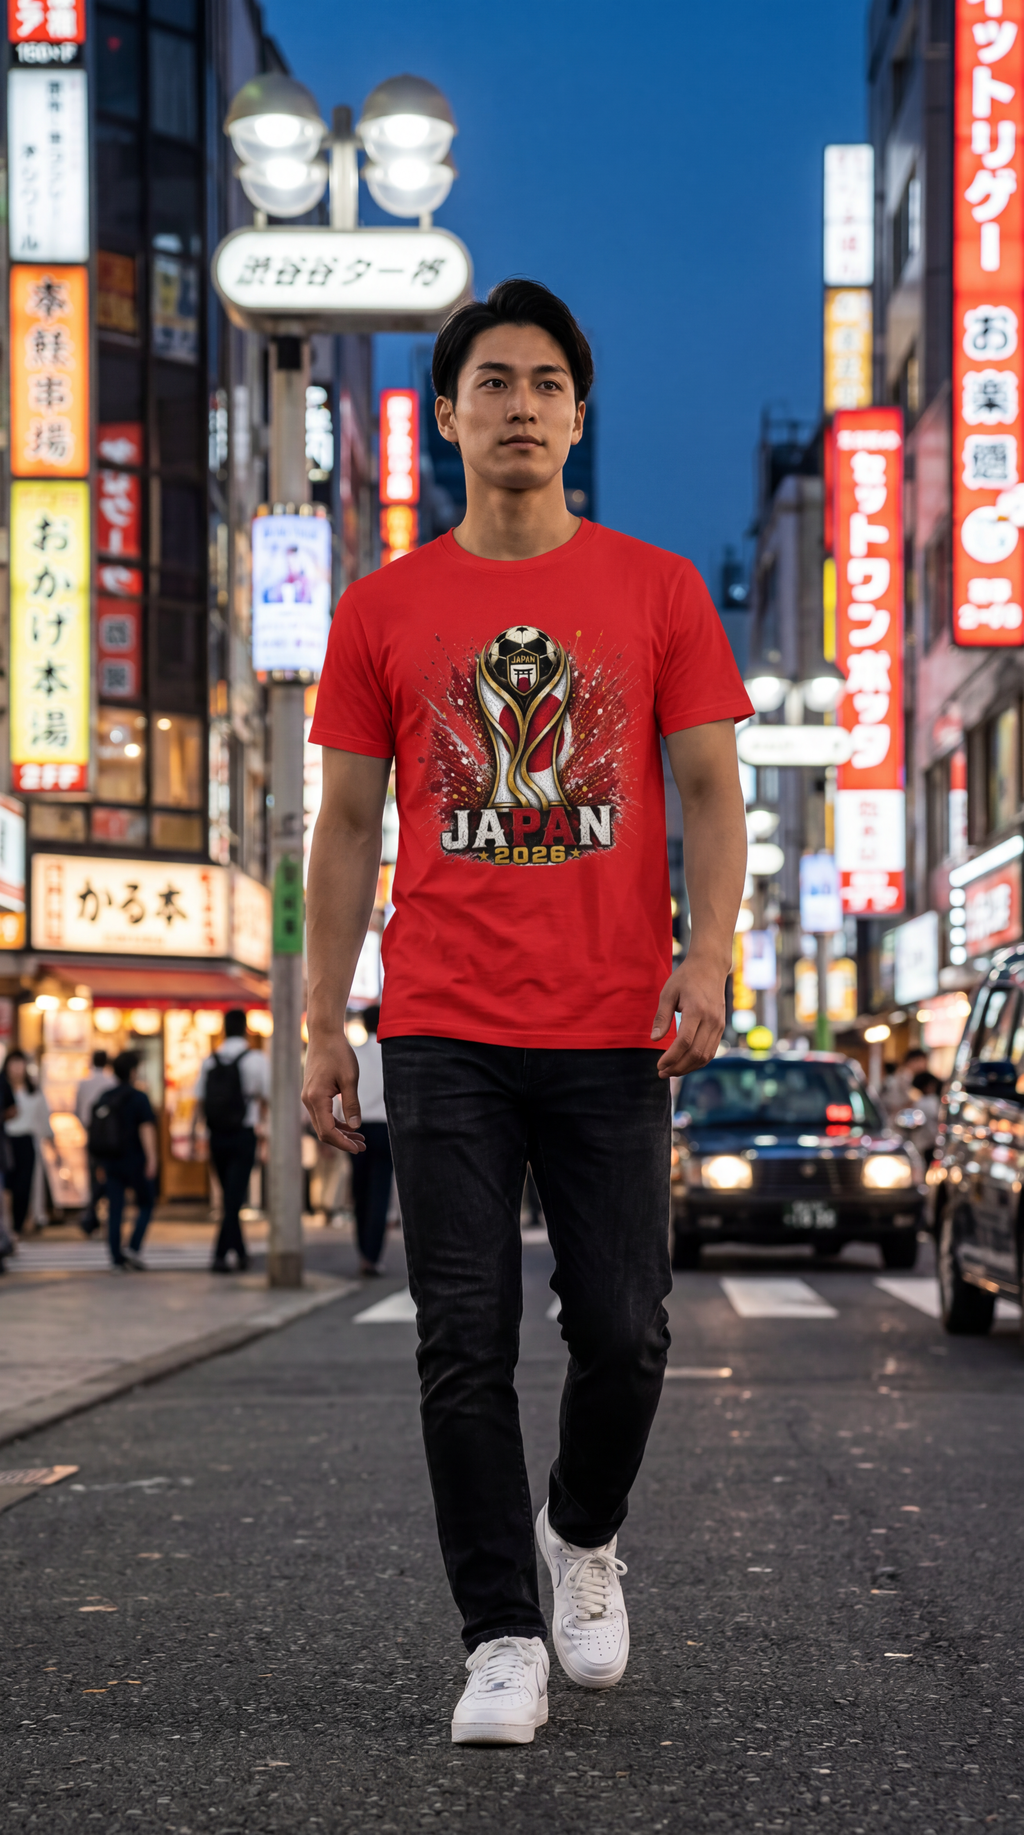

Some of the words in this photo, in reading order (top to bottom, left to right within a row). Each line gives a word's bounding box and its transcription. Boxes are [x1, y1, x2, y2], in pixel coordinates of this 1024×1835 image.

[510, 655, 536, 664] JAPAN
[441, 804, 613, 851] JAPAN
[494, 846, 567, 865] 2026
